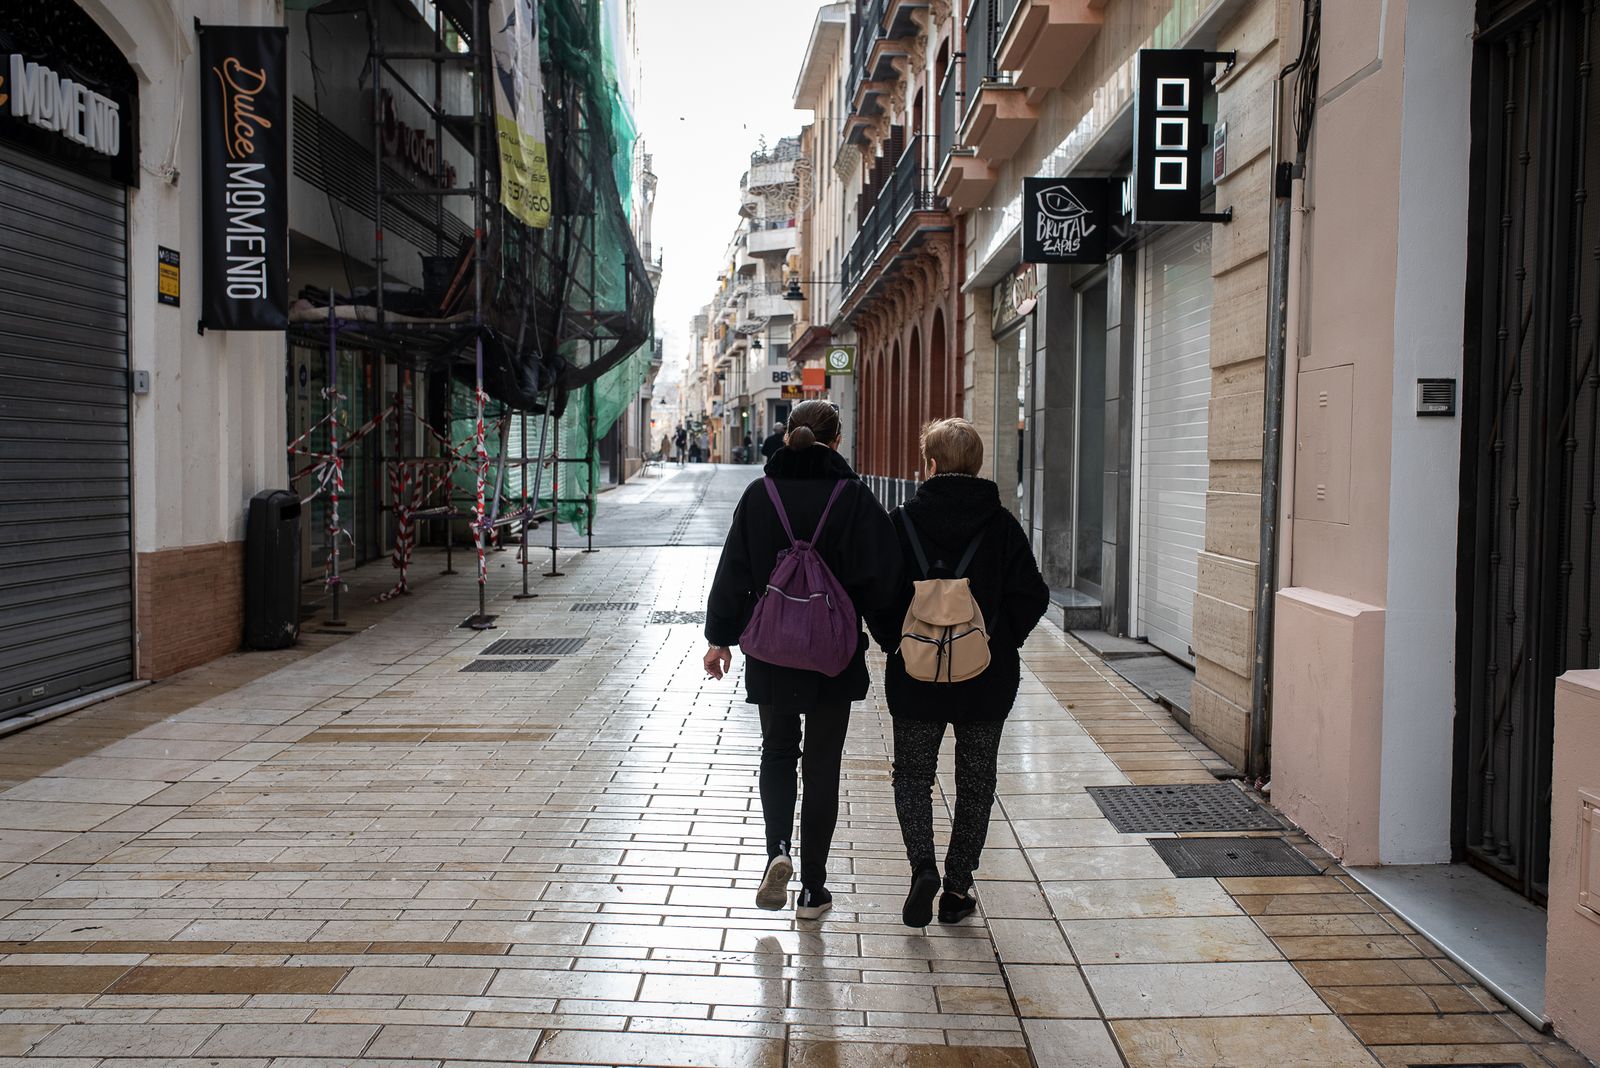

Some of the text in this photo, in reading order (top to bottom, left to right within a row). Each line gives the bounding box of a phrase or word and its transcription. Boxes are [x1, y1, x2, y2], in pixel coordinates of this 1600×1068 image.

[10, 53, 120, 157] MOMENTO
[214, 56, 272, 300] Dulce MOMENTO
[1036, 211, 1096, 242] BRUTAL
[1043, 237, 1081, 257] ZAPAS
